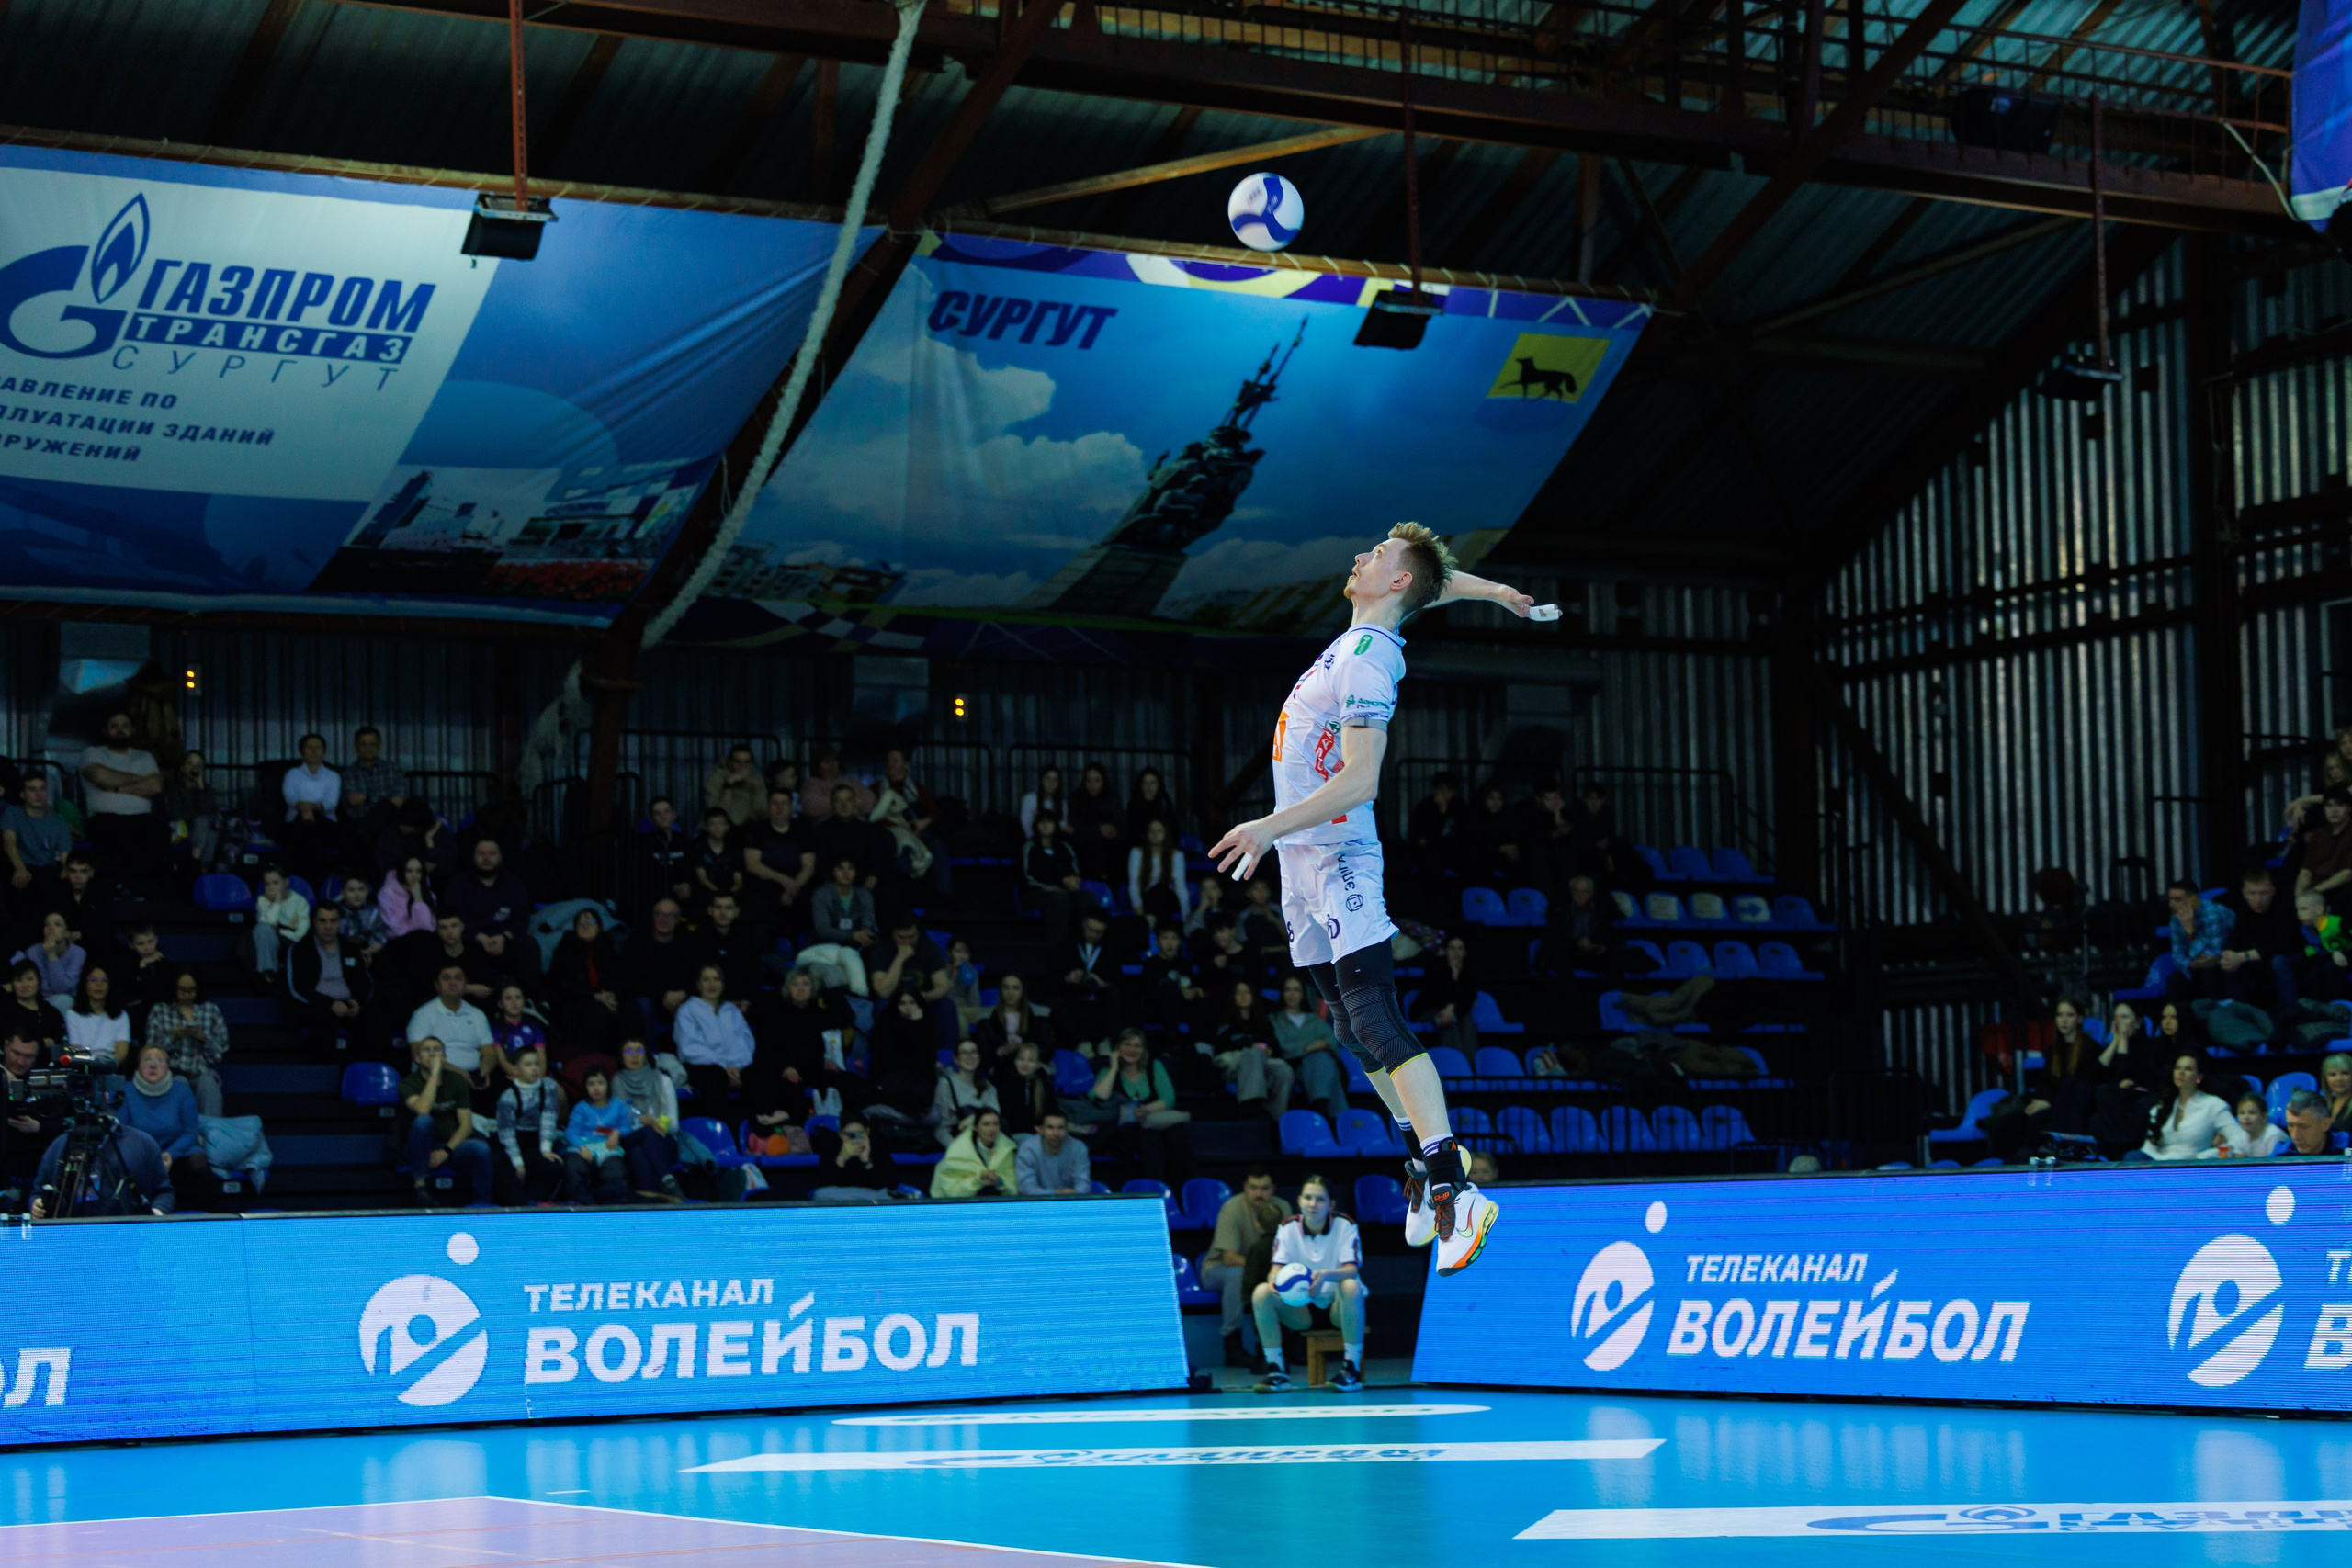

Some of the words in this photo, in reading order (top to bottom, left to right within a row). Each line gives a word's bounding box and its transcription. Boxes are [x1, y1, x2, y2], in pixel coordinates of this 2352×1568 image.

[138, 258, 437, 333] ГАЗПРОМ
[133, 316, 405, 363] ТРАНСГАЗ
[927, 290, 1119, 350] СУРГУТ
[111, 344, 399, 392] СУРГУТ
[0, 376, 134, 406] АВЛЕНИЕ
[140, 391, 178, 410] ПО
[0, 433, 141, 461] РУЖЕНИЙ
[162, 423, 276, 446] ЗДАНИЙ
[1686, 1253, 1869, 1283] ТЕЛЕКАНАЛ
[2326, 1250, 2352, 1286] Т
[524, 1279, 775, 1313] ТЕЛЕКАНАЛ
[1666, 1269, 2030, 1362] ВОЛЕЙБОЛ
[525, 1291, 980, 1384] ВОЛЕЙБОЛ
[0, 1347, 72, 1408] Л
